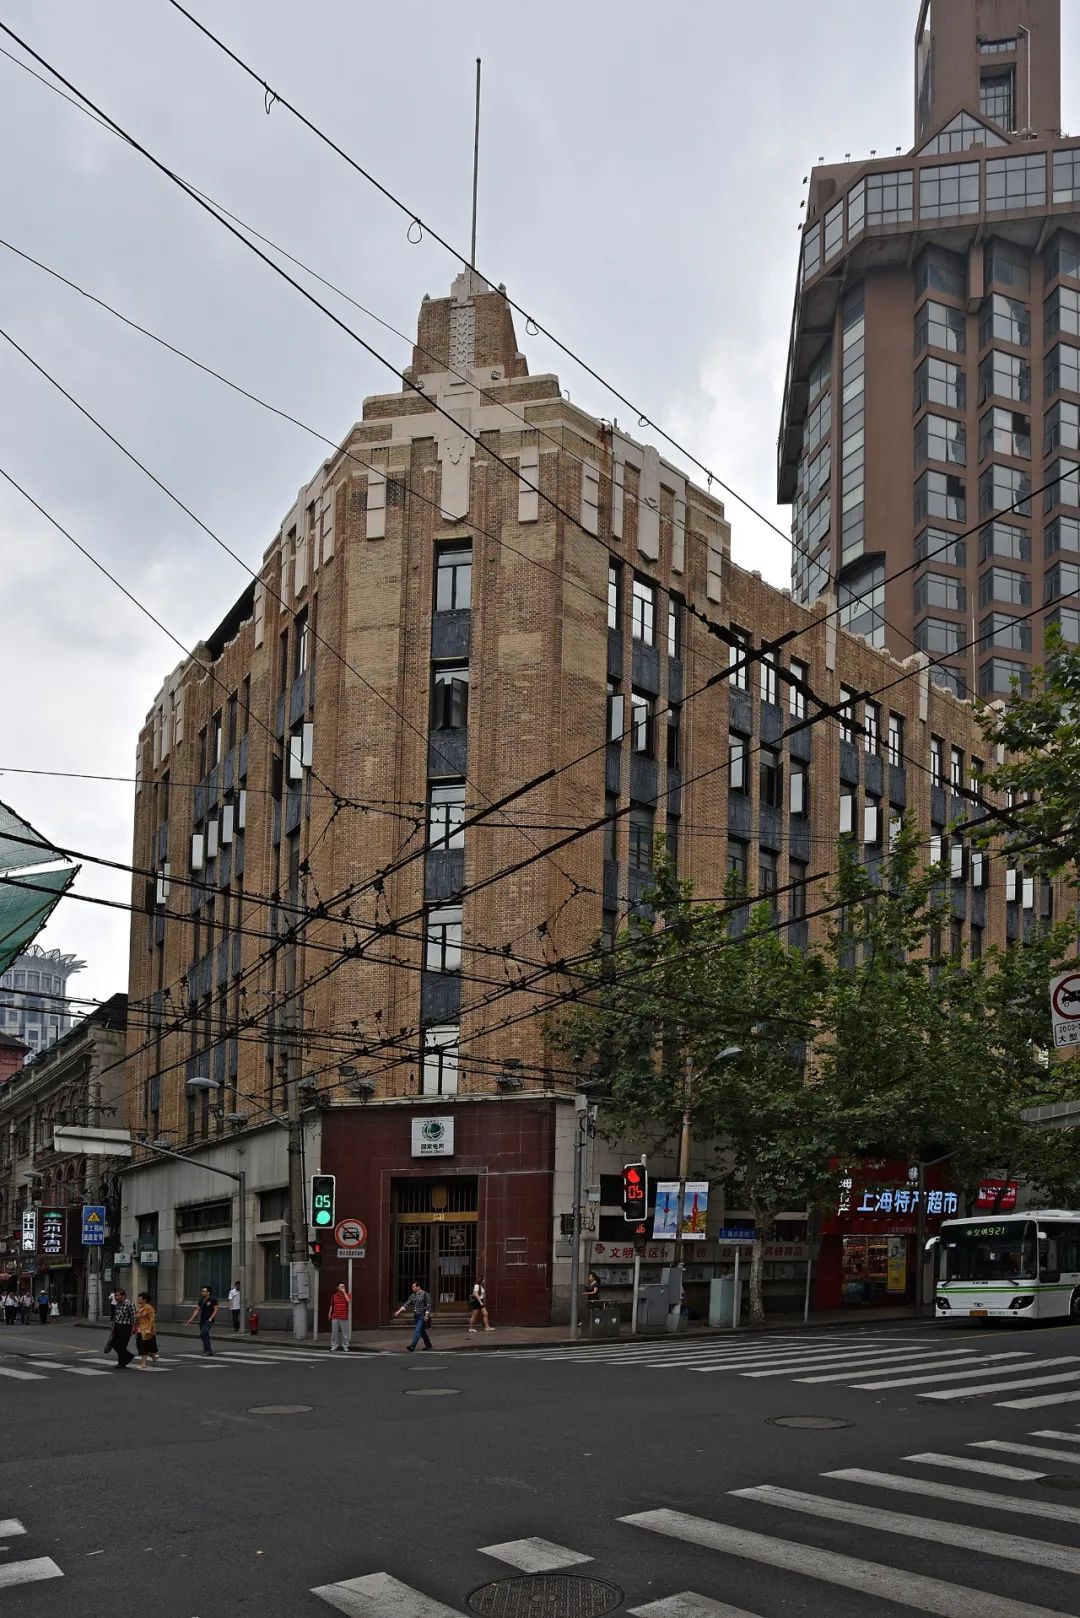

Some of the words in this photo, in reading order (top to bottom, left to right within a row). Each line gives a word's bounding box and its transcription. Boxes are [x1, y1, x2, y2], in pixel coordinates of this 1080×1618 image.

[1058, 1032, 1078, 1043] 大型
[628, 1185, 643, 1199] 05
[315, 1195, 331, 1207] 05
